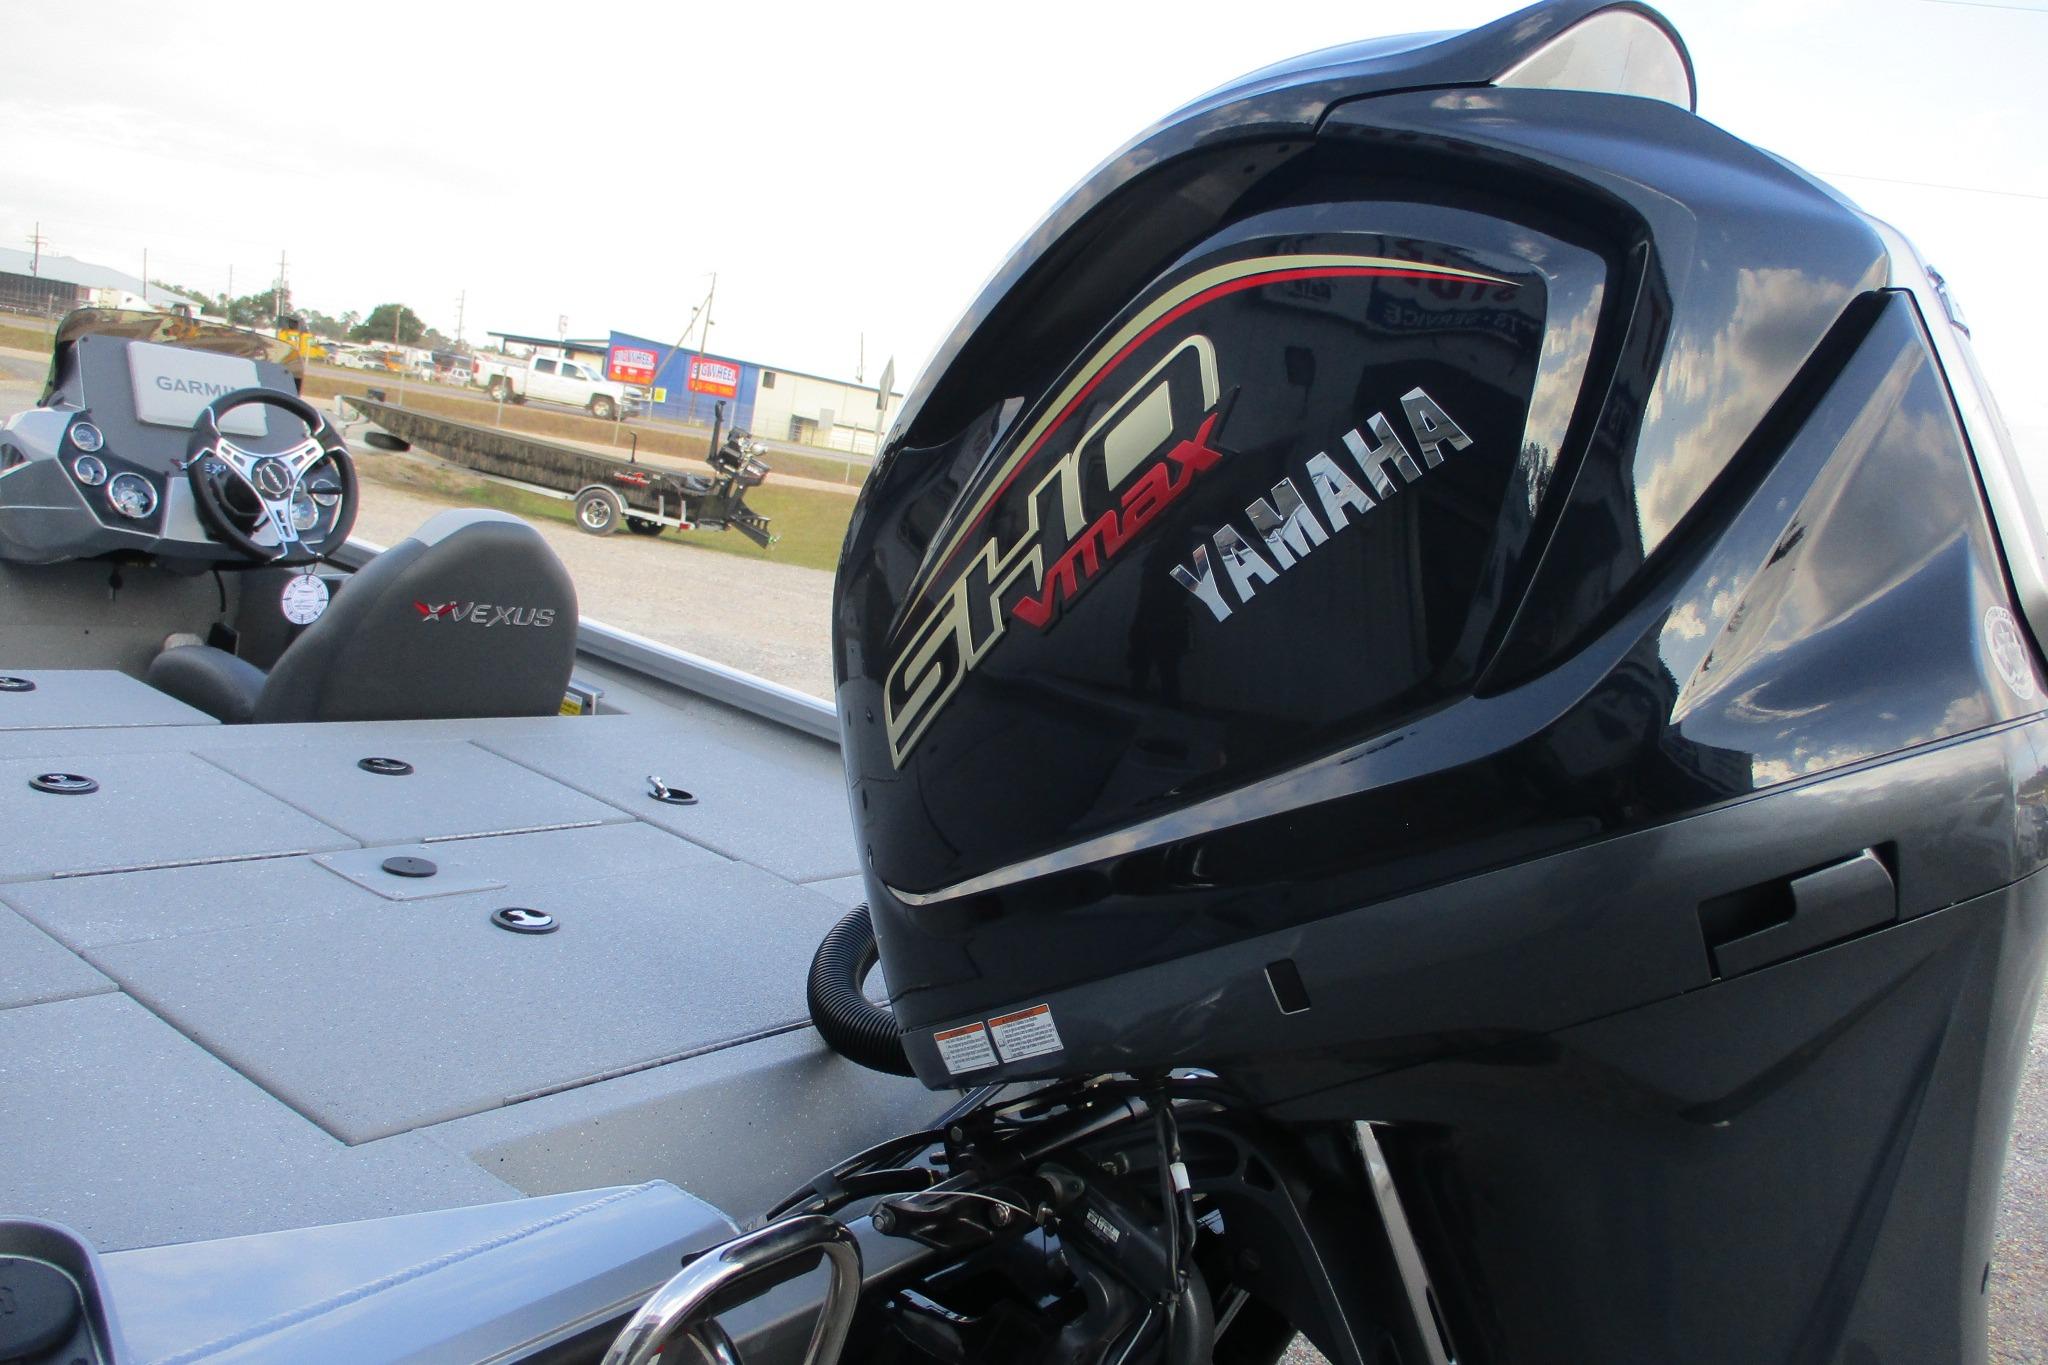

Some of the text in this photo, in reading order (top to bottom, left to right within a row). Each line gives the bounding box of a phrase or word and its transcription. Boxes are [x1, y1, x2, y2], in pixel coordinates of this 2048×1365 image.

[156, 375, 236, 397] GARMI
[1169, 386, 1474, 623] YAMAHA
[451, 601, 556, 627] VEXUS
